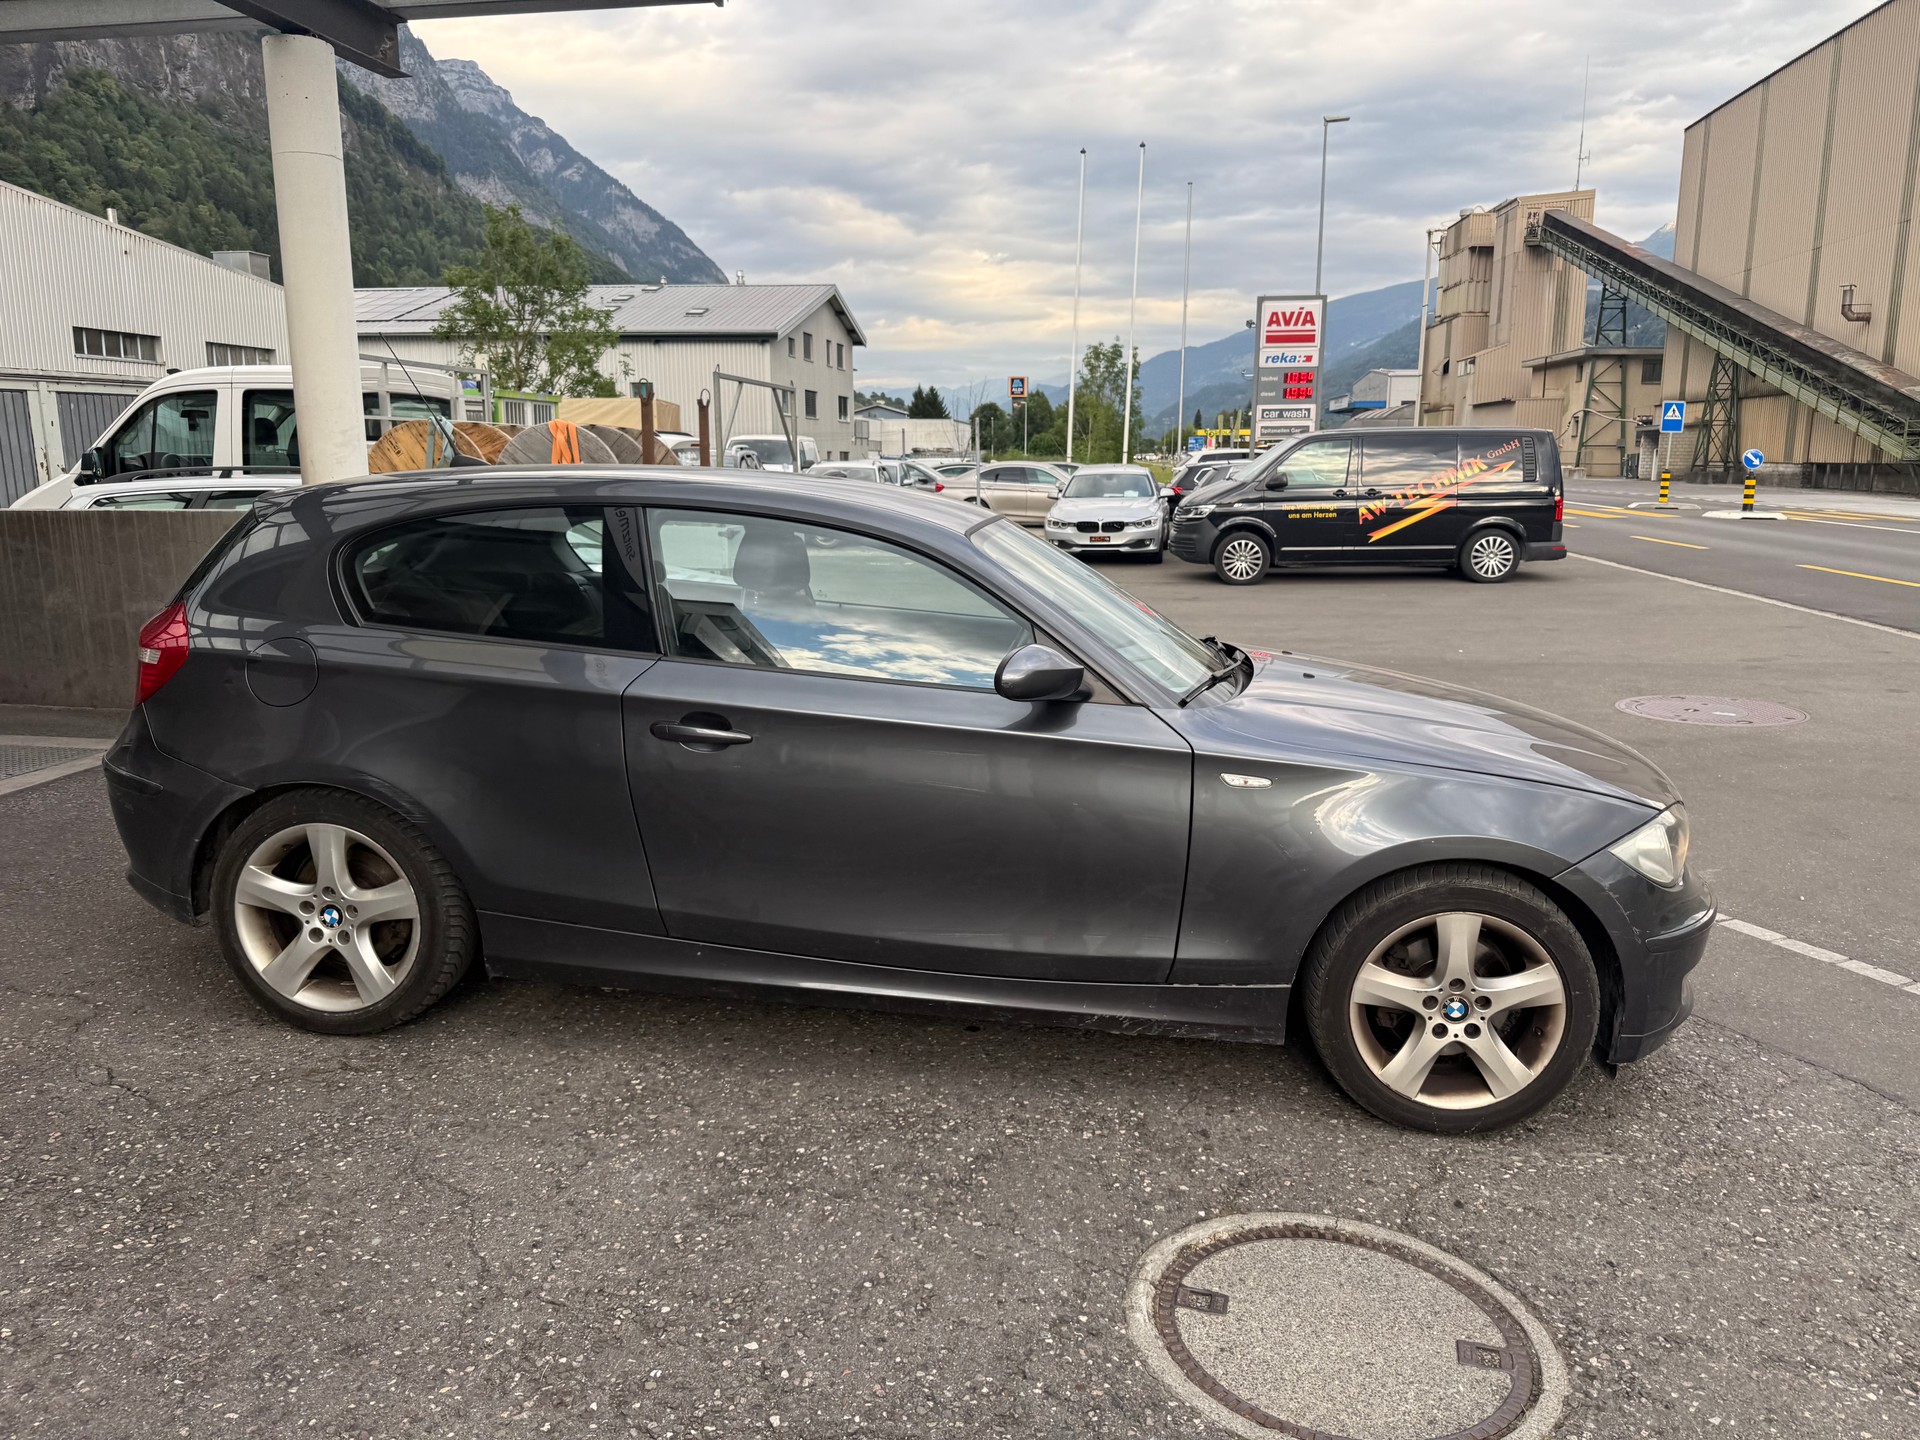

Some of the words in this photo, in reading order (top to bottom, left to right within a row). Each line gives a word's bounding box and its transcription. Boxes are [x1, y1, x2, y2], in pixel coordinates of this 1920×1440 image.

[1267, 307, 1316, 327] AVIA
[1282, 409, 1308, 418] wash
[1487, 439, 1521, 459] GmbH
